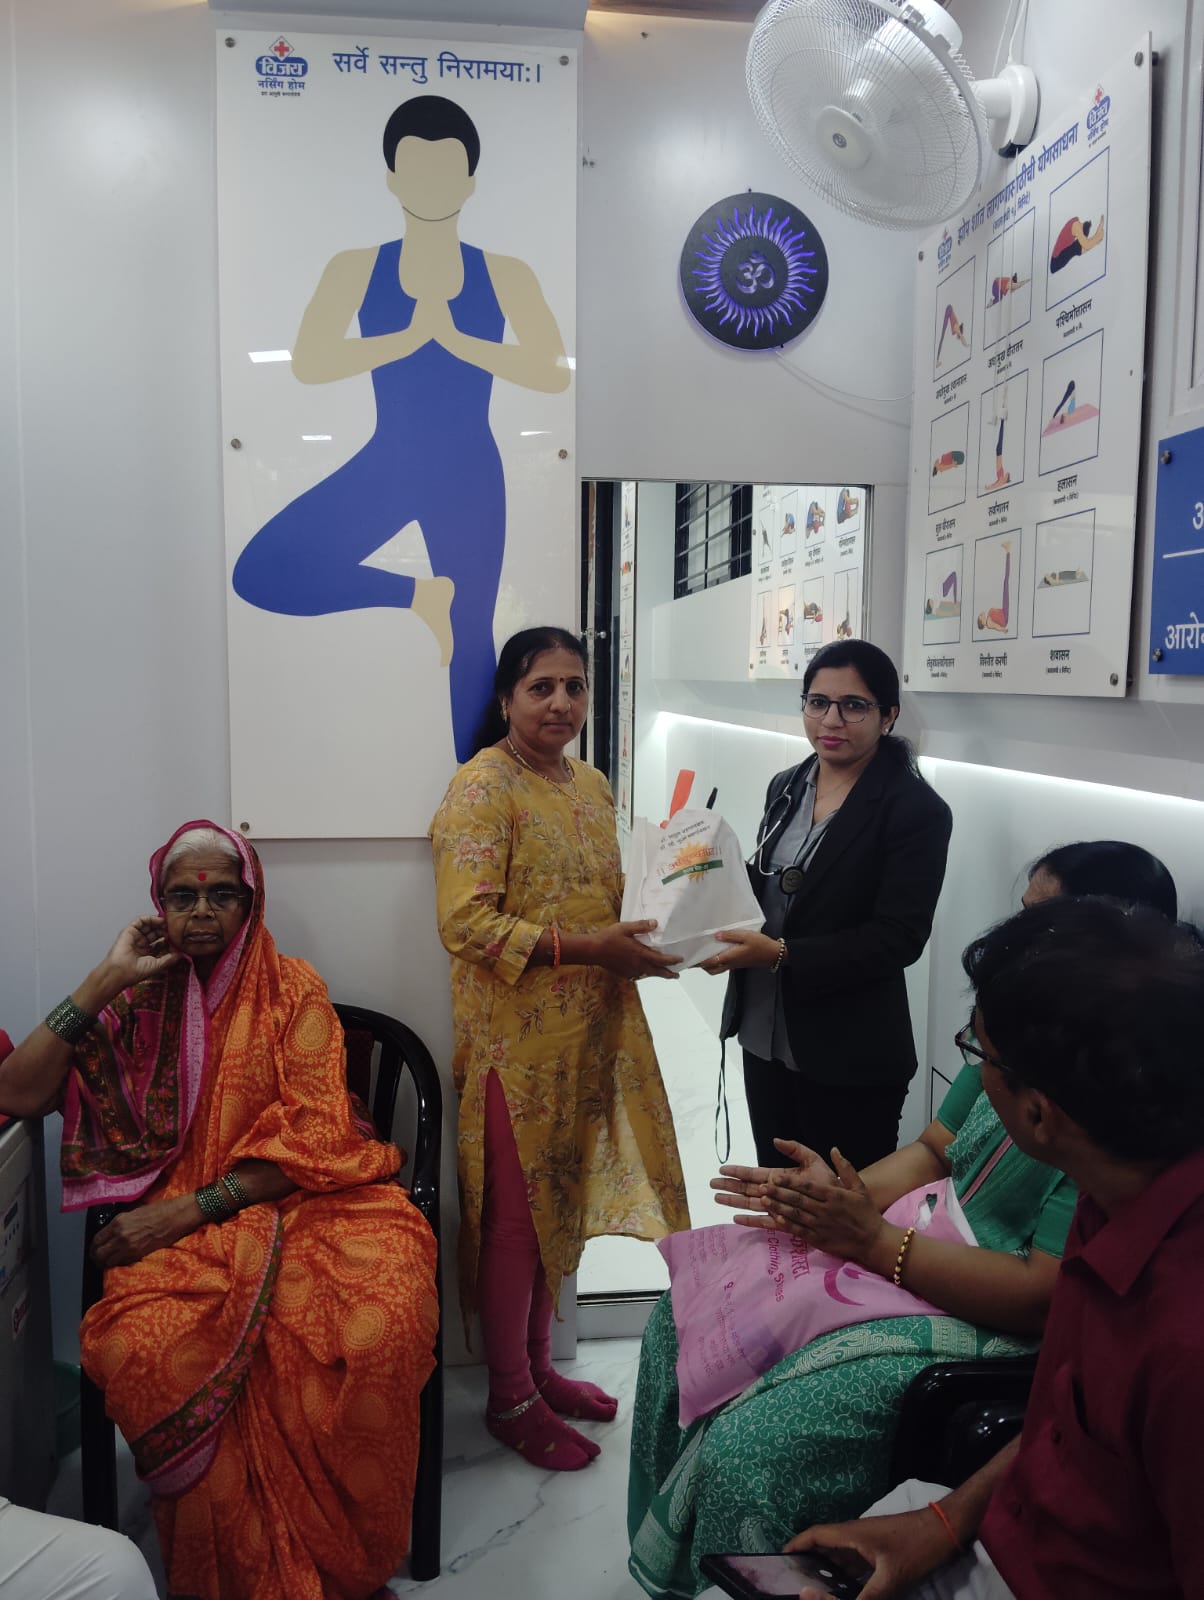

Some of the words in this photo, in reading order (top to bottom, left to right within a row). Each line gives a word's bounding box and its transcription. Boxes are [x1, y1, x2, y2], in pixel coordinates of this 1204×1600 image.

[287, 78, 305, 90] होम
[332, 46, 369, 74] सर्वे
[378, 55, 428, 84] सन्तु
[1038, 122, 1079, 173] योगसाधना
[1164, 611, 1204, 650] आरो
[1050, 649, 1070, 661] शवासन
